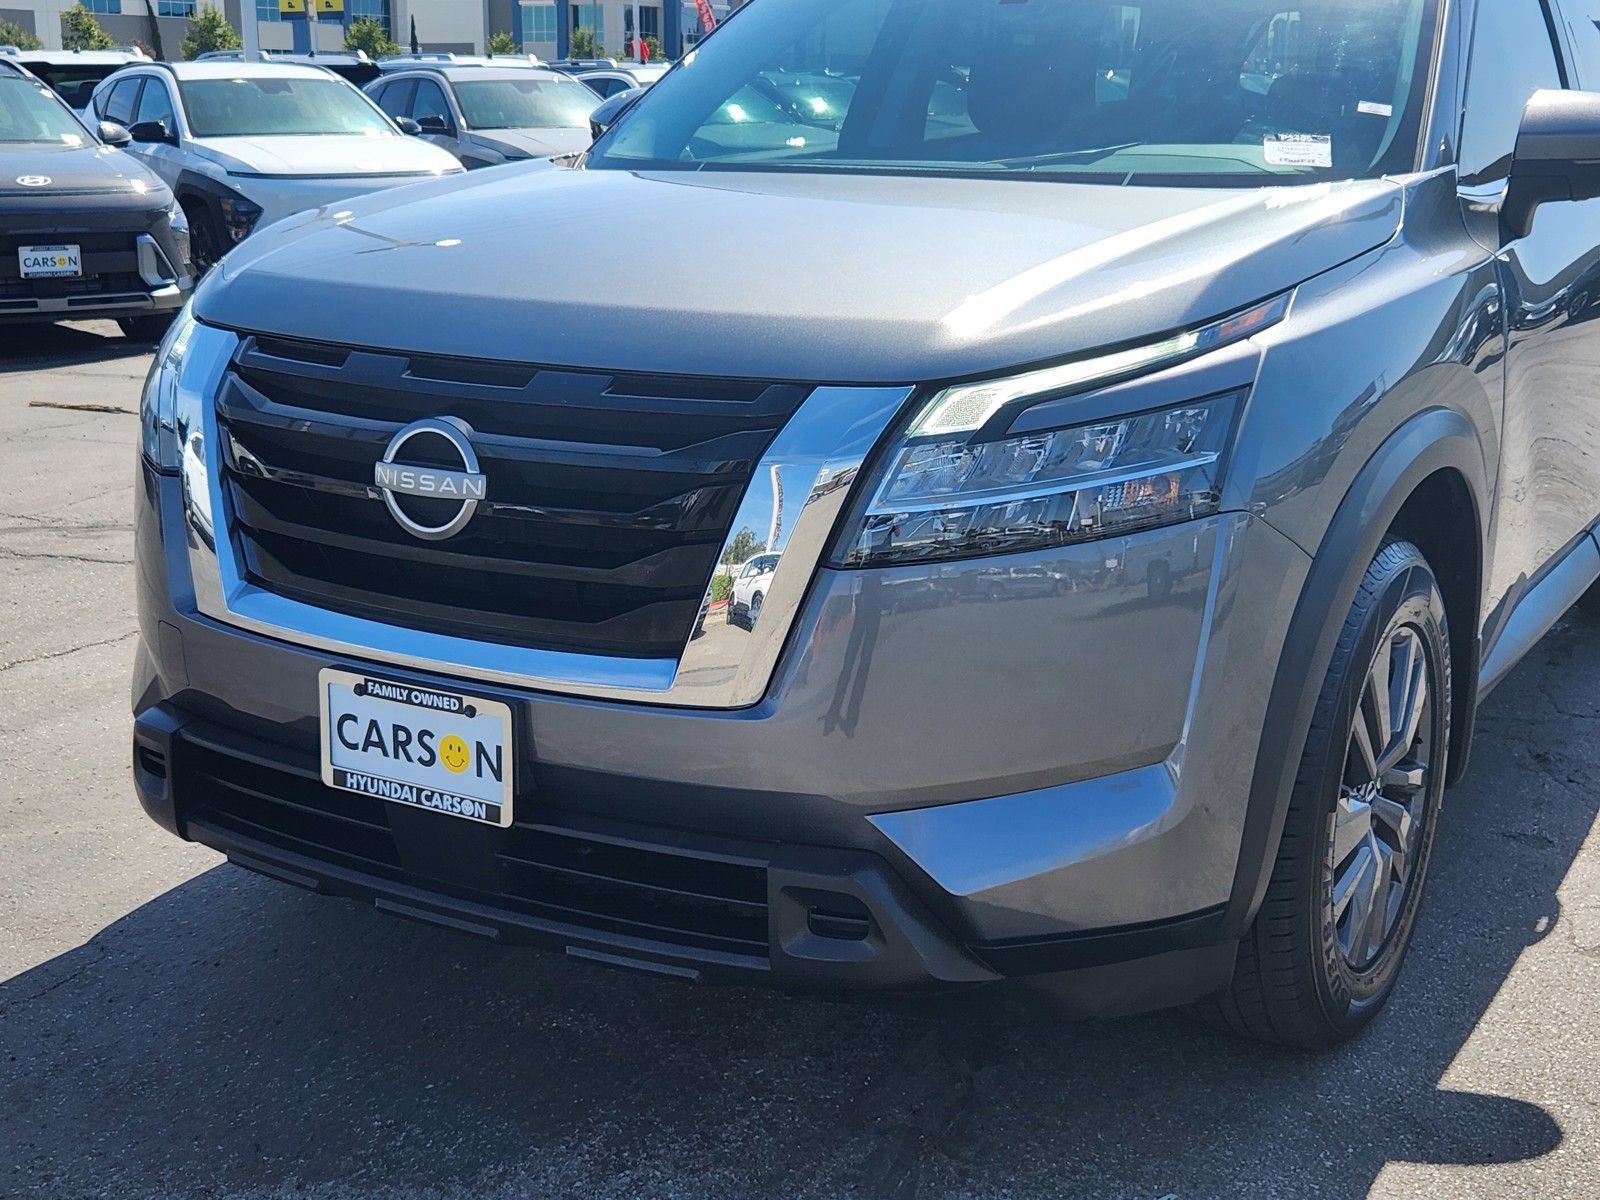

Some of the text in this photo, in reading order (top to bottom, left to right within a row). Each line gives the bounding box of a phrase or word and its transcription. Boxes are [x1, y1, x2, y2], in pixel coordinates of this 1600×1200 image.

[377, 466, 482, 496] NISSAN
[367, 682, 460, 711] FAMILY OWNED
[345, 772, 487, 820] HYUNDAI CARSON
